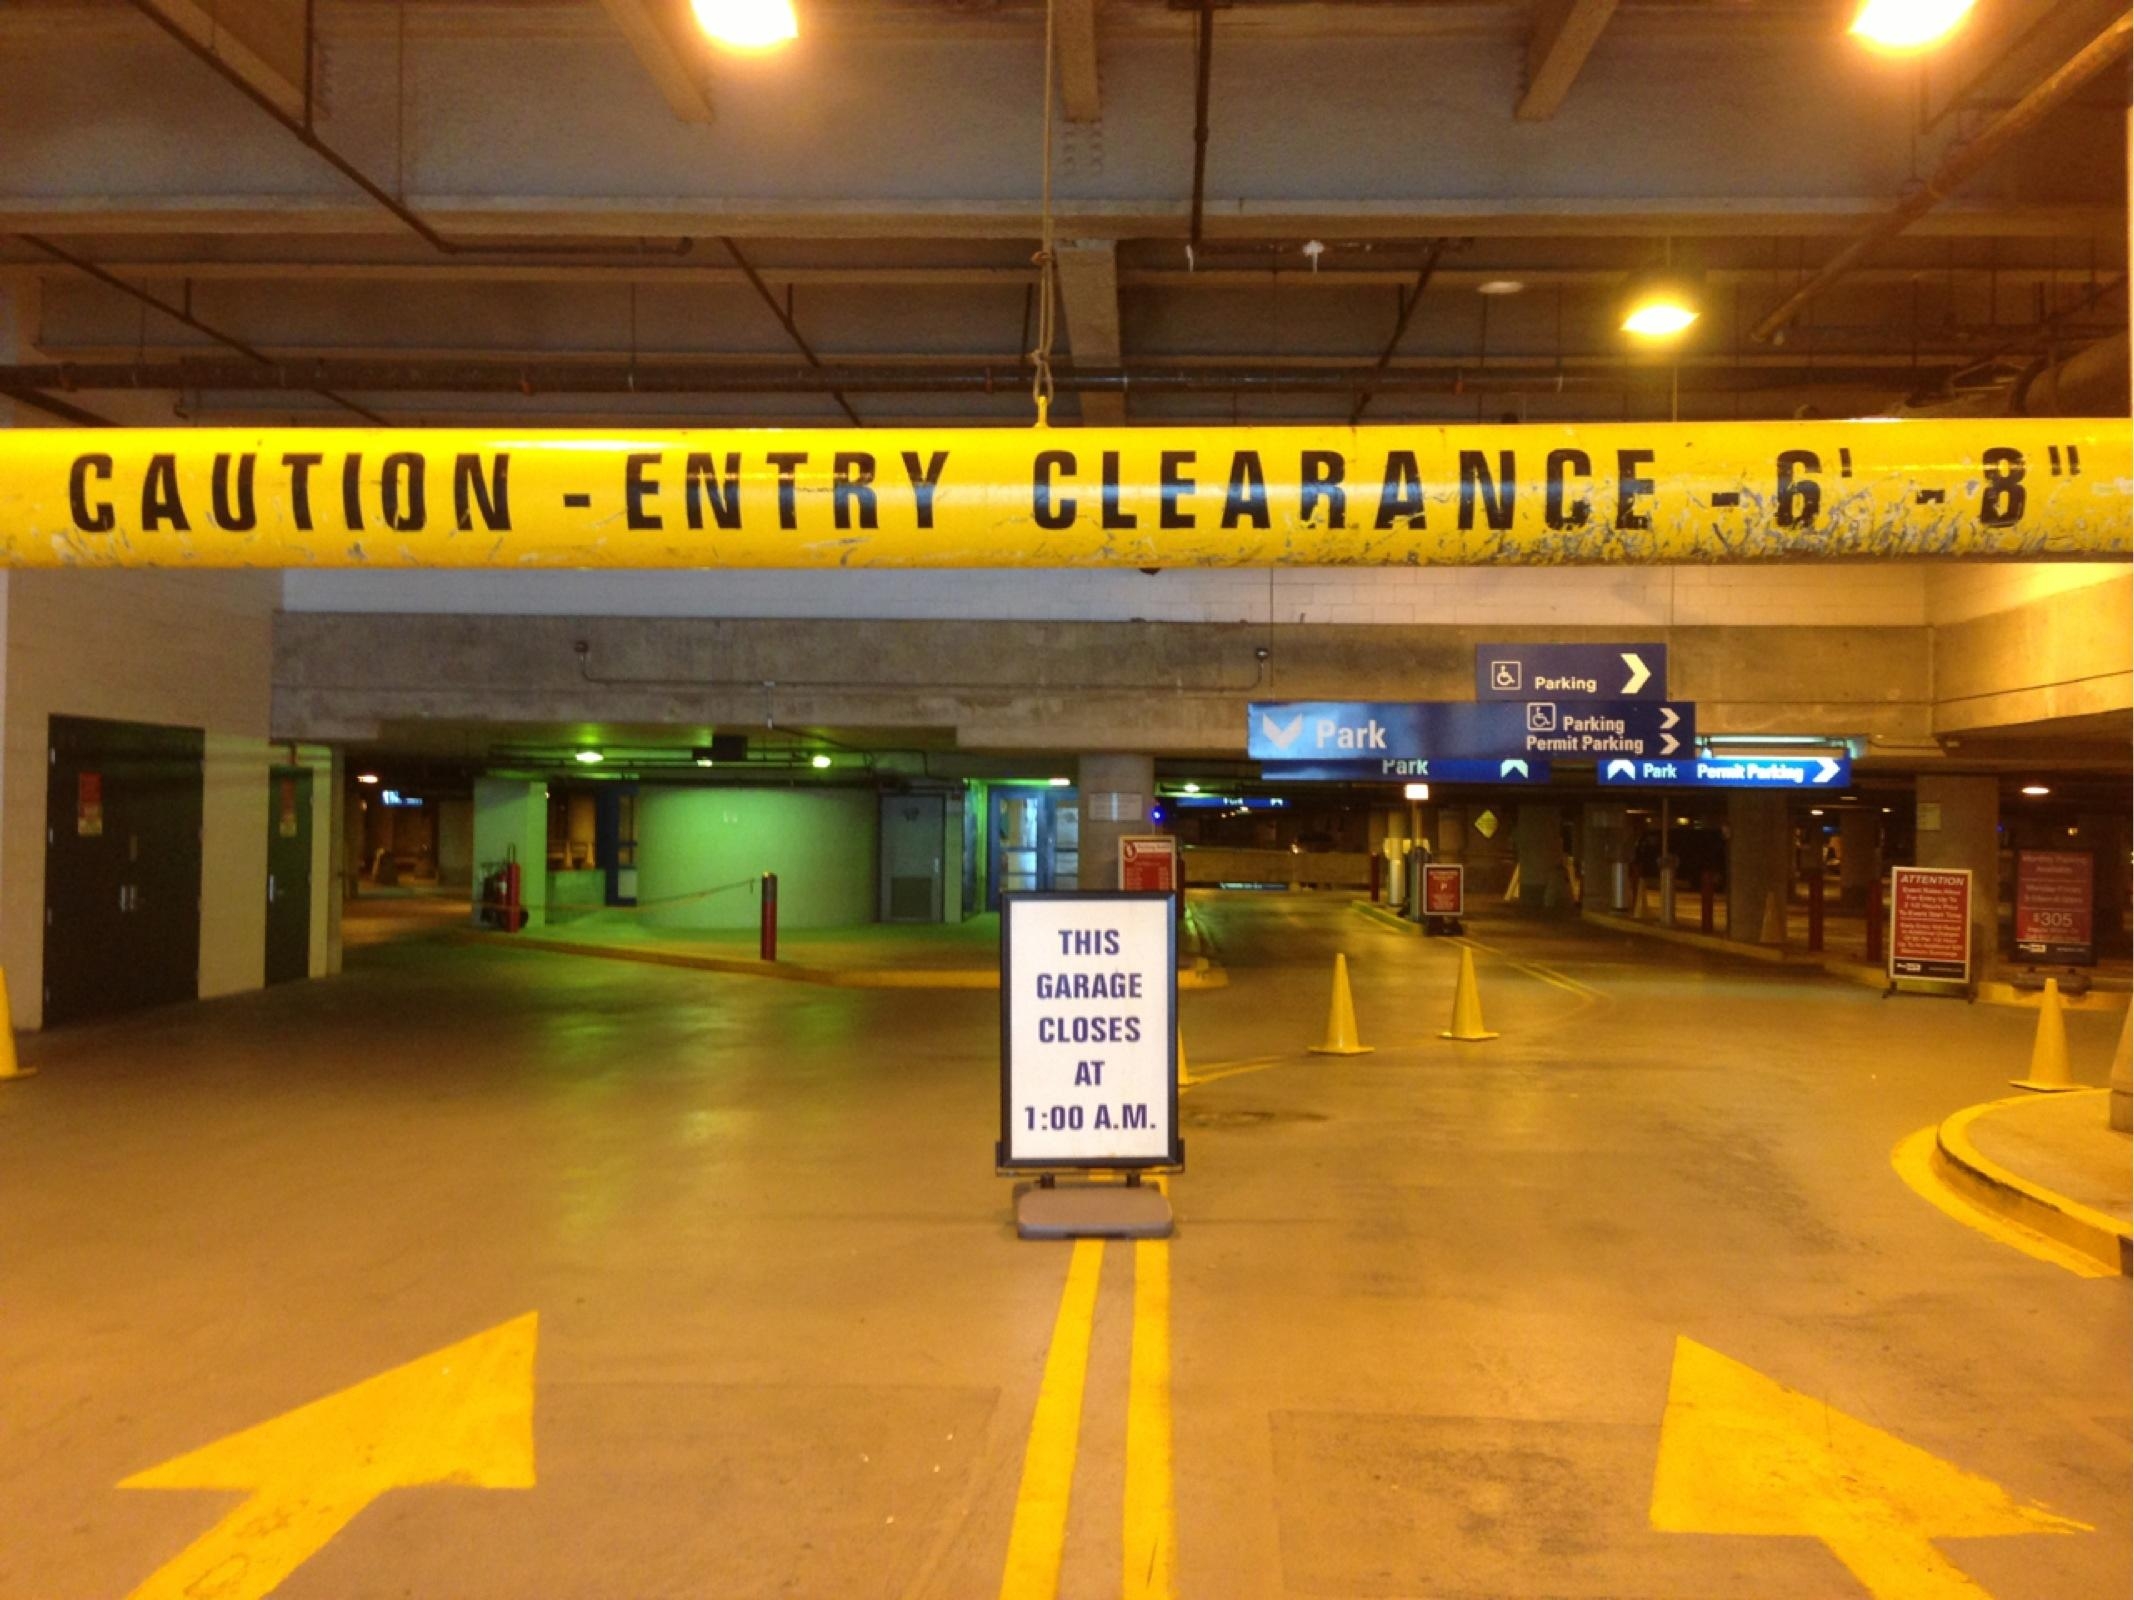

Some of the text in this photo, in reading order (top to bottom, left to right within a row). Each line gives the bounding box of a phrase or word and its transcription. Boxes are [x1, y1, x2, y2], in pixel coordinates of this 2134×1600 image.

[68, 452, 513, 533] CAUTION
[1032, 449, 1655, 531] CLEARANCE
[1534, 676, 1598, 693] Parking
[1315, 719, 1387, 749] Park
[1562, 714, 1626, 734] Parking
[1526, 734, 1644, 754] Permit Parking
[1382, 759, 1429, 776] Park
[1642, 763, 1804, 784] Park Permit Parking
[1900, 873, 1966, 886] ATTENTION
[2032, 911, 2073, 928] $305
[1058, 929, 1120, 955] THIS
[1036, 973, 1142, 999] GARAGE
[1038, 1016, 1141, 1043] CLOSES
[1074, 1060, 1105, 1086] AT
[1025, 1103, 1156, 1130] 1:00 A.M.
